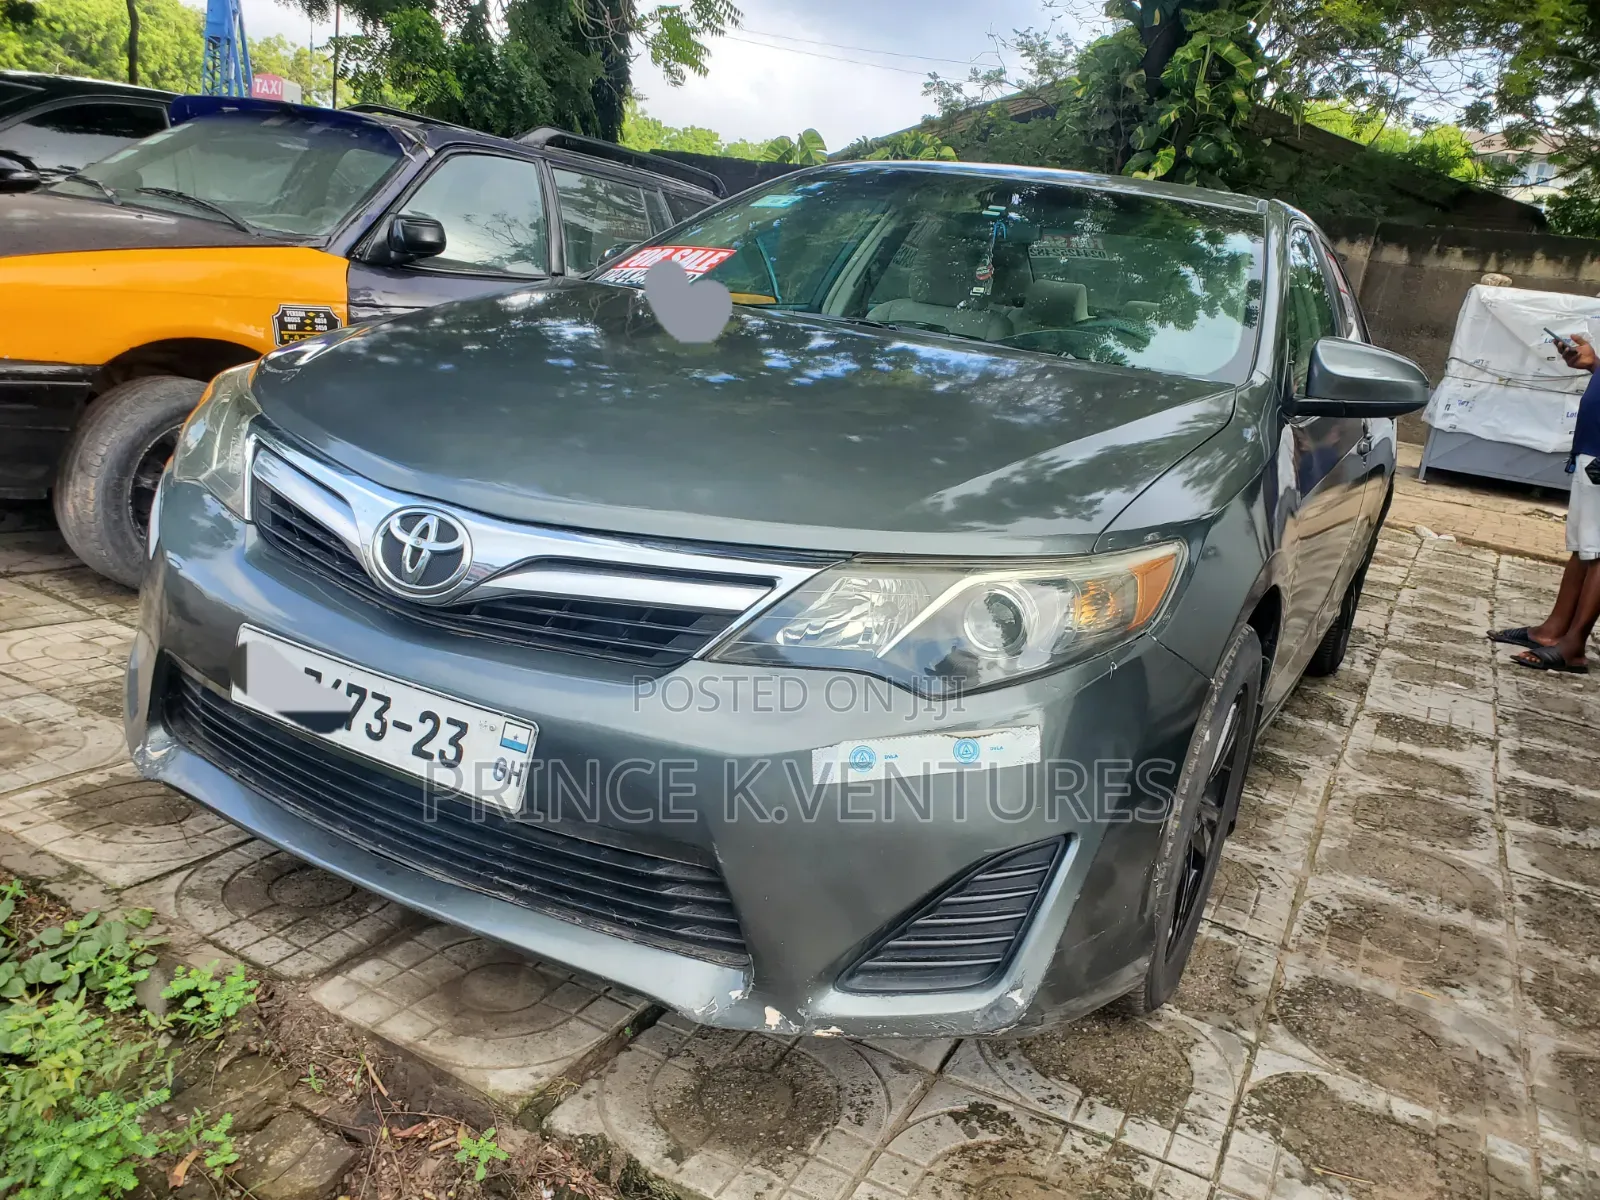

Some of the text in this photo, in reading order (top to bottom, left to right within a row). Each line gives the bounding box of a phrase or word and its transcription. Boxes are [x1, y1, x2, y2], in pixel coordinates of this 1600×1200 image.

[255, 78, 282, 95] TAXI
[616, 248, 730, 271] FOR SALE
[493, 756, 524, 788] GH
